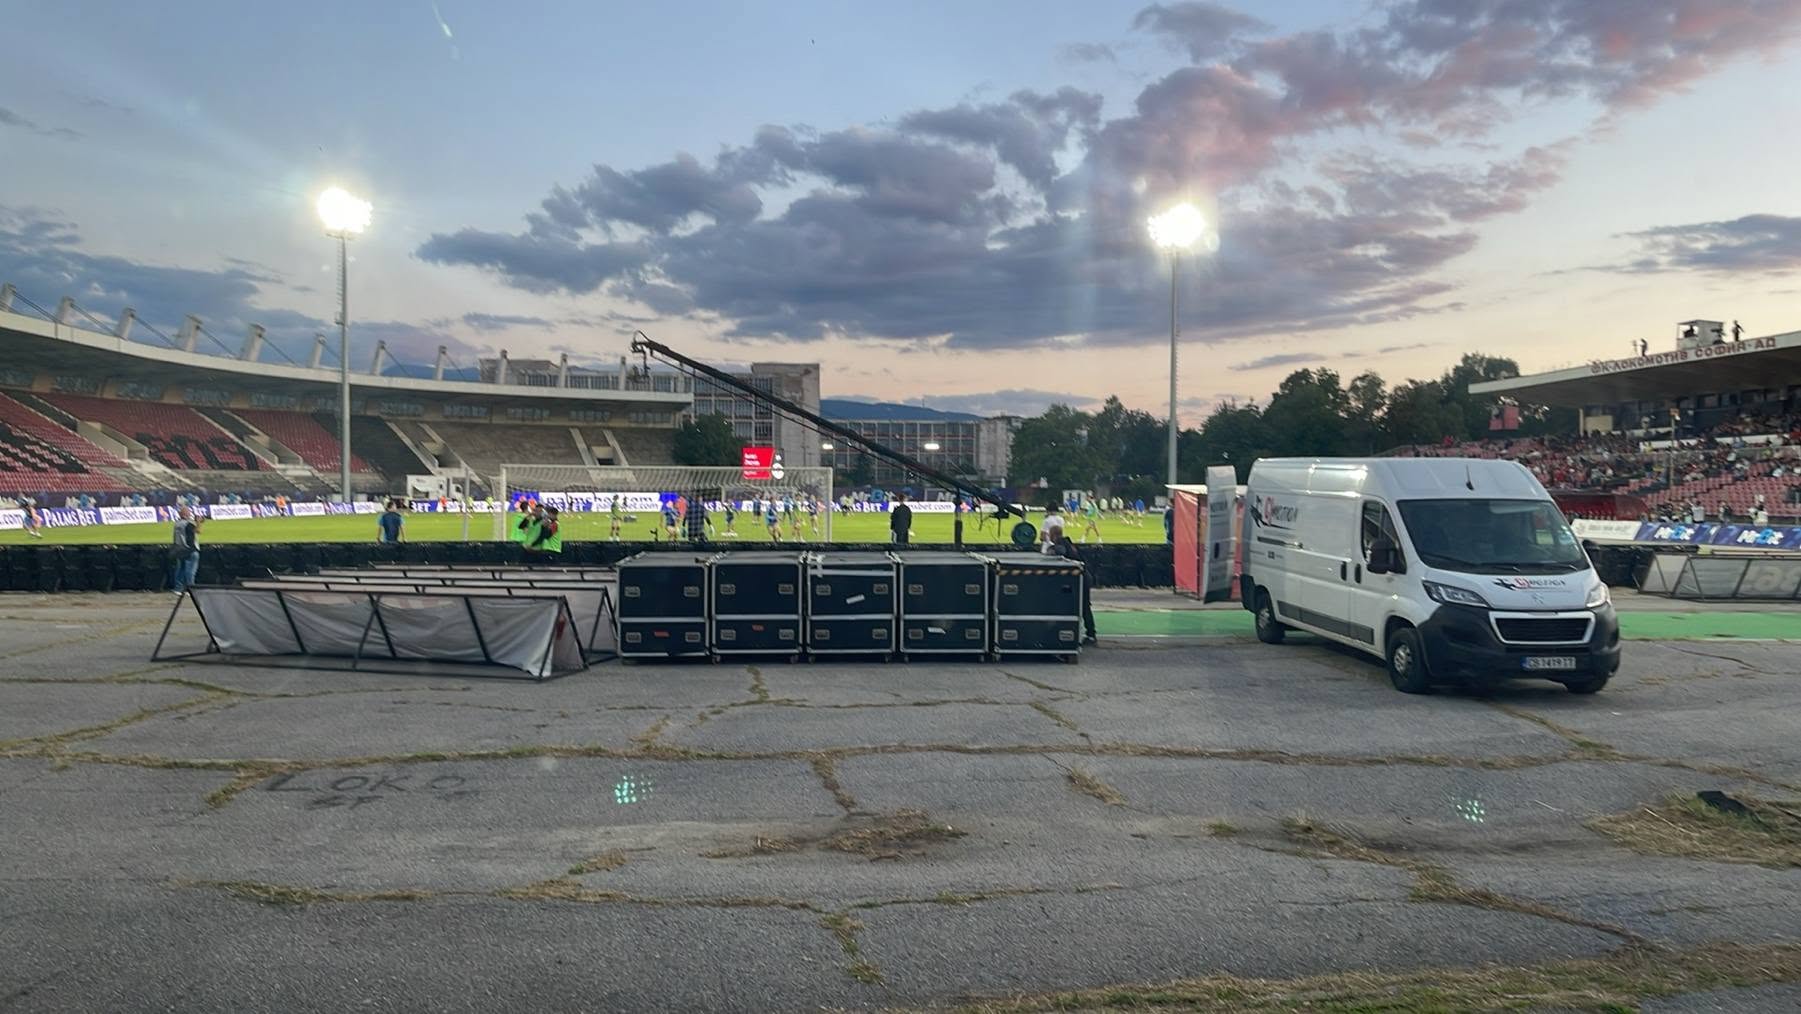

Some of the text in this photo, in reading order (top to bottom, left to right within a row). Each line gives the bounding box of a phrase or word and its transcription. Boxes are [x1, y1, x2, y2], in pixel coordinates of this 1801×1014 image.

[862, 501, 882, 513] BET
[41, 508, 98, 528] PALMS BET
